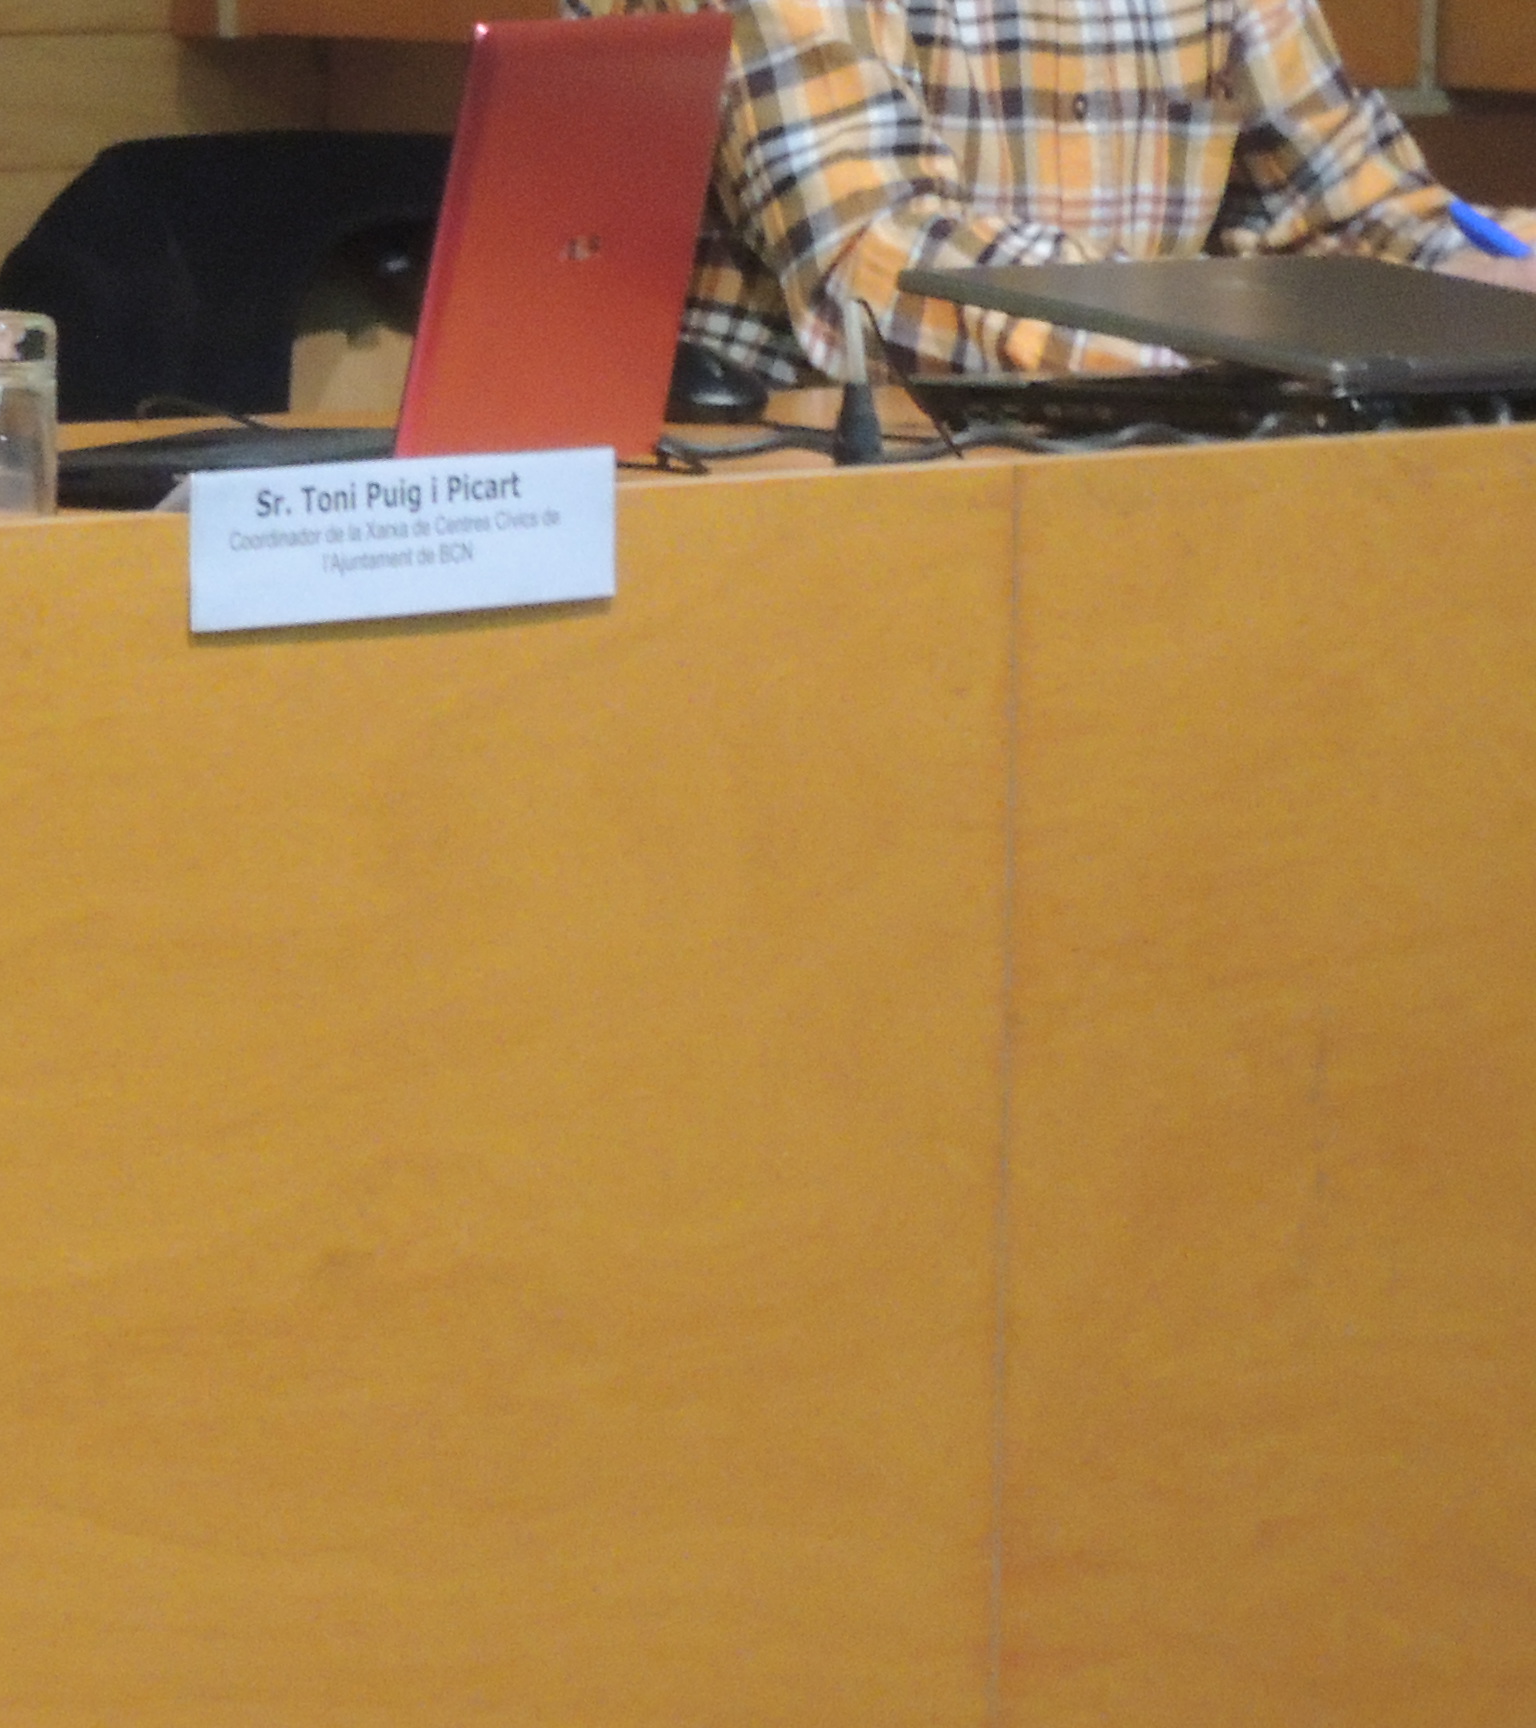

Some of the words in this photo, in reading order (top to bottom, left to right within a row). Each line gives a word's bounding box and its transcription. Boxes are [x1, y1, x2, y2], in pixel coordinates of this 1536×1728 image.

[256, 489, 292, 518] Sr.
[301, 481, 356, 514] Toni
[366, 477, 422, 513] Puig
[431, 476, 438, 504] i
[447, 471, 522, 502] Picart
[229, 526, 321, 552] Coordinador
[325, 524, 344, 545] de
[348, 522, 362, 542] la
[412, 517, 431, 537] de
[542, 508, 561, 527] de
[416, 546, 435, 566] de
[439, 541, 474, 565] BCN
